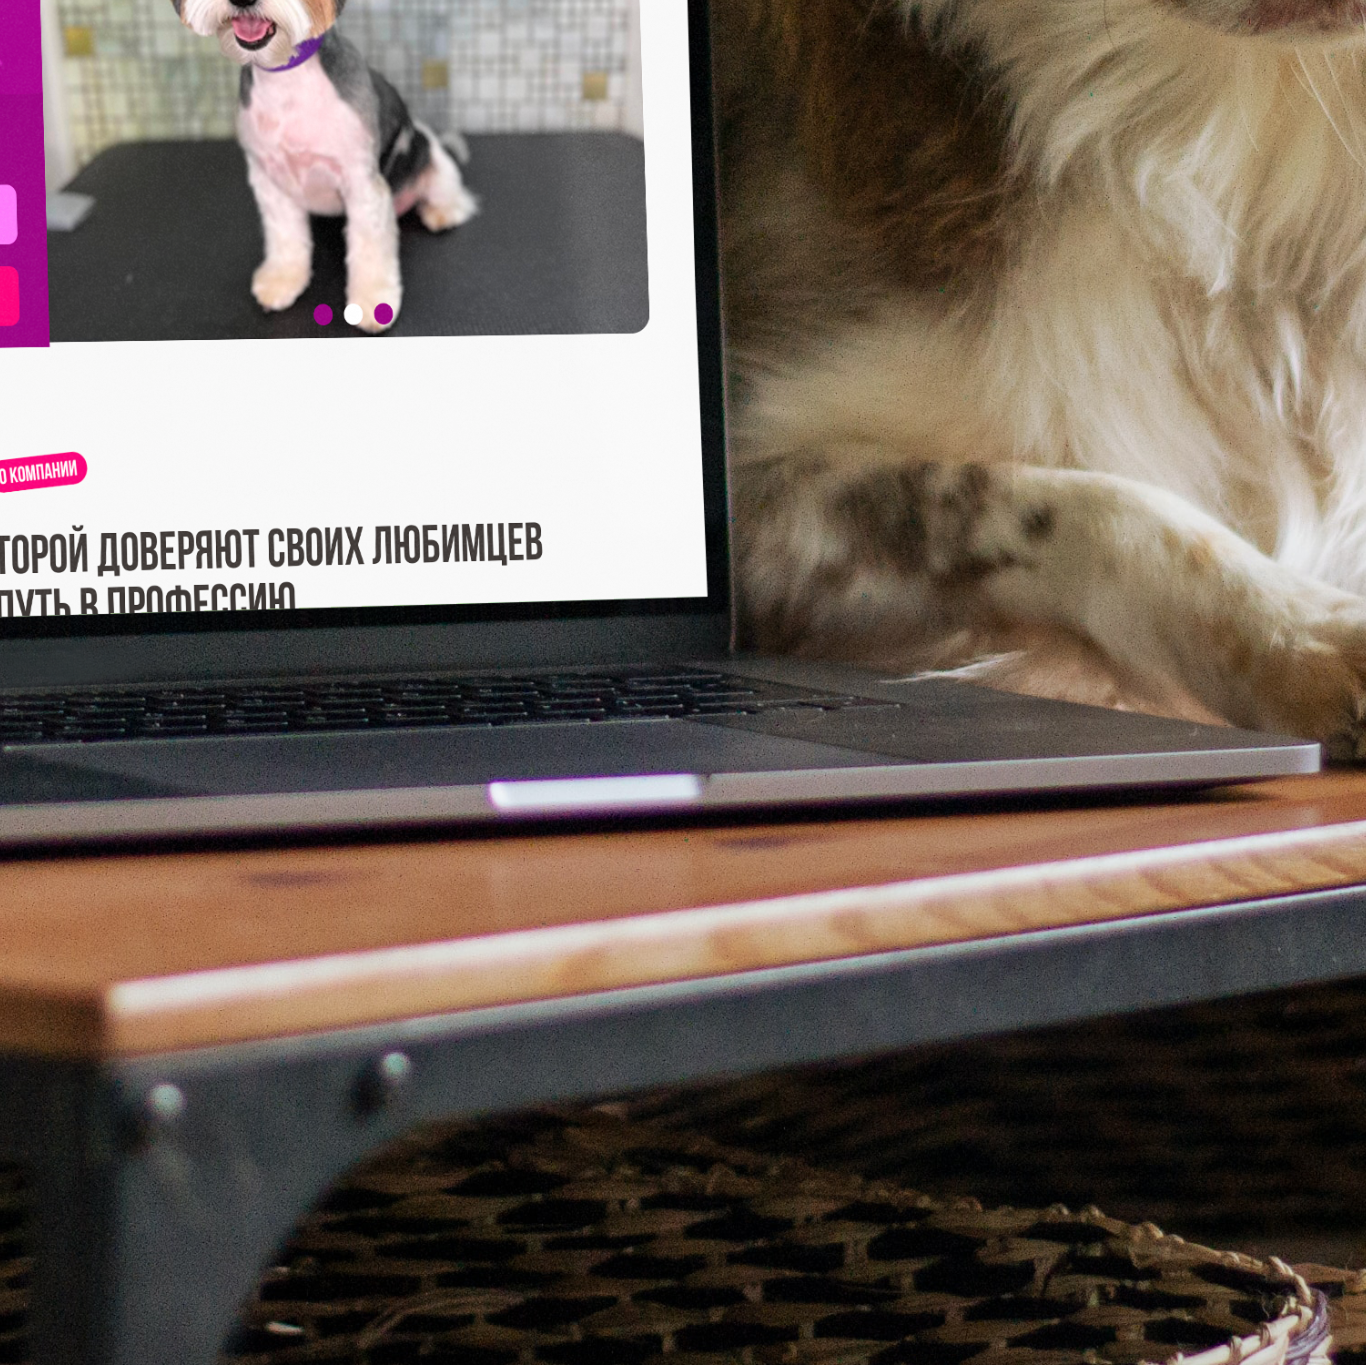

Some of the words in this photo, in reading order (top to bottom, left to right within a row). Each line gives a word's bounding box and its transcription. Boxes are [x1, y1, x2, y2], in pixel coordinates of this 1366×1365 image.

[10, 460, 78, 483] КОМПАНИИ
[97, 528, 260, 577] ДОВЕРЯЮТ
[267, 526, 365, 568] СВОИХ
[372, 521, 543, 567] ЛЮБИМЦЕВ
